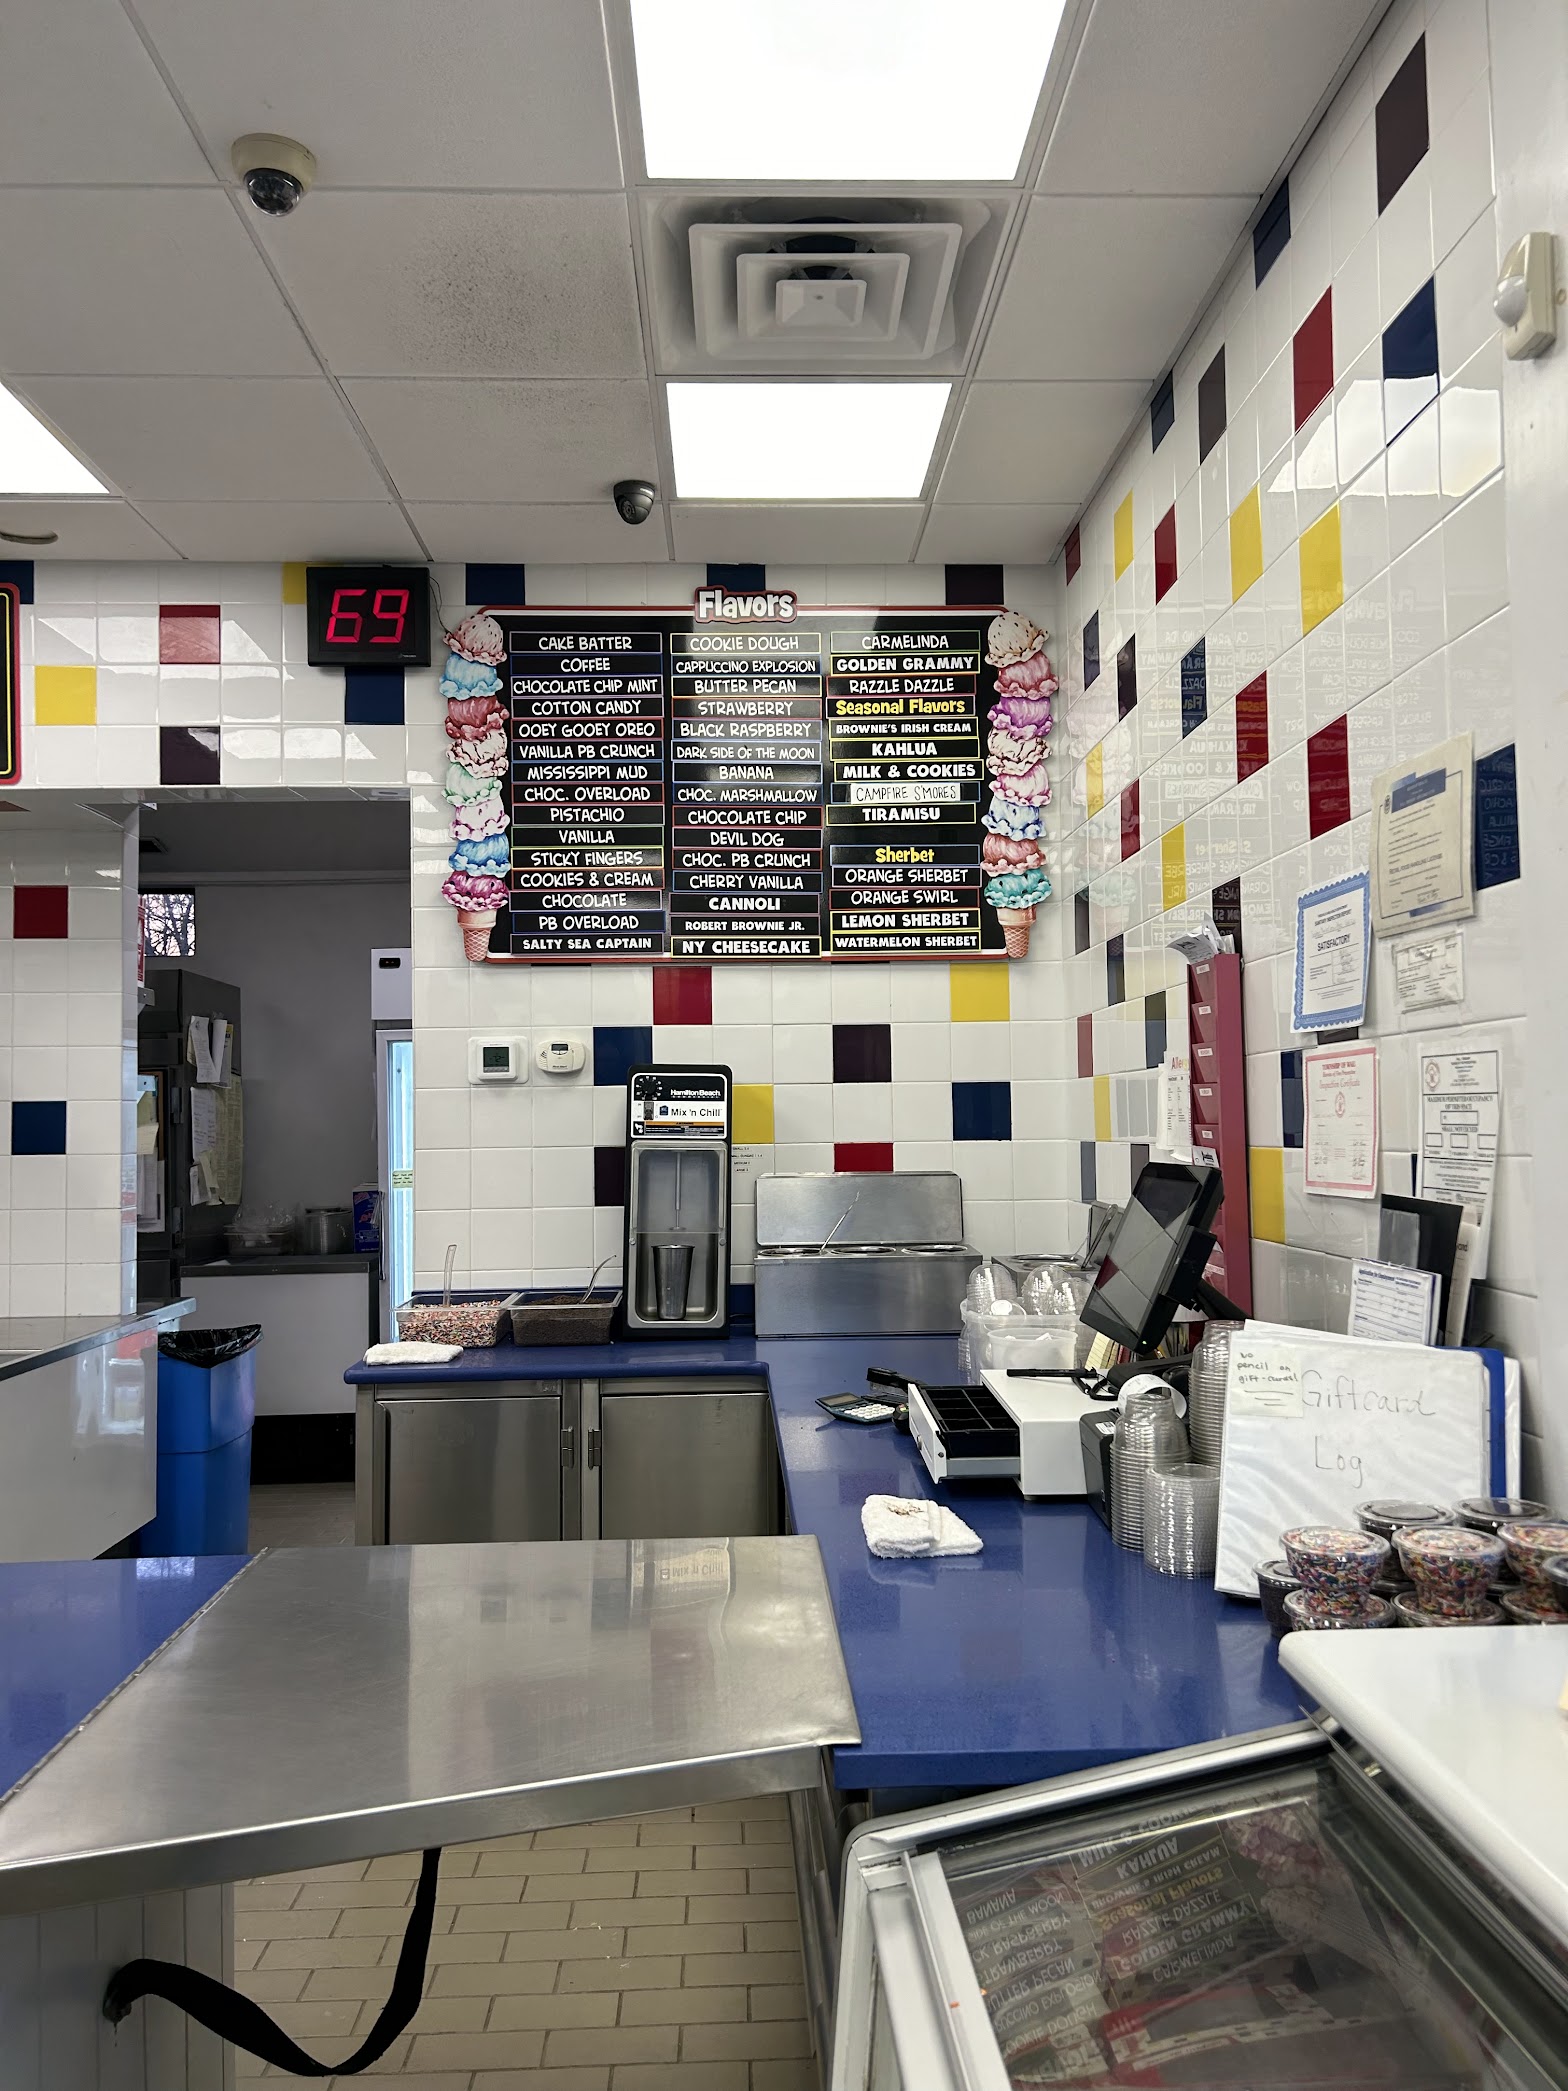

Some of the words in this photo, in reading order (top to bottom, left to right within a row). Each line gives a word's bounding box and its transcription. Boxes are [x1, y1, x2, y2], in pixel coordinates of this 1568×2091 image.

[699, 591, 793, 619] Flavors
[326, 588, 410, 643] 69
[539, 637, 574, 650] CAKE
[578, 637, 632, 649] BATTER
[690, 637, 744, 651] COOKIE
[748, 636, 799, 650] DOUGH
[862, 635, 949, 650] CARMELINDA
[561, 658, 610, 672] COFFEE
[676, 661, 748, 673] CAPPUCCINO
[752, 660, 816, 672] EXPLOSION
[837, 657, 896, 671] GOLDEN
[902, 657, 974, 670] GRAMMY
[513, 680, 590, 693] CHOCOLATE
[594, 680, 623, 693] CHIP
[628, 679, 657, 692] MINT
[694, 680, 748, 693] BUTTER
[753, 679, 796, 693] PECAN
[849, 679, 900, 693] RAZZLE
[904, 678, 954, 692] DAZZLE
[532, 701, 591, 715] COTTON
[596, 700, 641, 714] CANDY
[698, 702, 793, 716] STRAWBERRY
[836, 699, 904, 715] Seasonal
[909, 699, 965, 714] Flavors
[519, 723, 556, 738] OOEY
[561, 723, 609, 738] GOOEY
[615, 722, 655, 737] OREO
[680, 723, 725, 737] BLACK
[730, 723, 811, 737] RASPBERRY
[836, 723, 897, 733] BROWNIE'S
[901, 723, 929, 733] IRISH
[933, 723, 971, 733] CREAM
[520, 745, 573, 759] VANILLA
[577, 745, 595, 758] PB
[600, 744, 654, 758] CRUNCH
[676, 747, 707, 759] DARK
[709, 747, 736, 759] SIDE
[739, 746, 752, 759] OF
[755, 746, 776, 758] THE
[779, 747, 814, 759] MOON
[872, 743, 937, 756] KAHLUA
[527, 766, 610, 780] MISSISSIPPI
[616, 766, 648, 779] MUD
[719, 766, 774, 780] BANANA
[843, 766, 882, 779] MILK
[888, 766, 901, 778] &
[906, 765, 975, 777] COOKIES
[524, 788, 569, 802] CHOC.
[574, 787, 650, 801] OVERLOAD
[678, 789, 716, 802] CHOC.
[720, 789, 817, 802] MARSHMALLOW
[856, 787, 909, 801] CAMPFIRE
[550, 808, 624, 822] PISTACHIO
[688, 810, 772, 825] CHOCOLATE
[776, 811, 806, 825] CHIP
[862, 808, 940, 821] TIRAMISU
[559, 830, 614, 844] VANILLA
[710, 832, 748, 846] DEVIL
[752, 832, 784, 846] DOG
[531, 852, 581, 867] STICKY
[585, 852, 643, 866] FINGERS
[682, 853, 727, 868] CHOC.
[731, 853, 750, 867] PB
[755, 853, 811, 868] CRUNCH
[875, 847, 934, 864] Sherbet
[520, 873, 584, 887] COOKIES
[589, 874, 599, 887] &
[604, 873, 653, 887] CREAM
[690, 875, 744, 889] CHERRY
[748, 874, 804, 890] VANILLA
[845, 869, 903, 883] ORANGE
[907, 869, 969, 882] SHERBET
[542, 894, 627, 908] CHOCOLATE
[709, 897, 781, 911] CANNOLI
[850, 891, 909, 905] ORANGE
[913, 890, 958, 904] SWIRL
[539, 917, 558, 931] PB
[562, 916, 639, 930] OVERLOAD
[685, 922, 728, 931] ROBERT
[731, 922, 785, 931] BROWNIE
[788, 921, 805, 931] JR.
[842, 915, 896, 928] LEMON
[901, 913, 969, 927] SHERBET
[523, 939, 562, 951] SALTY
[568, 939, 591, 950] SEA
[596, 938, 651, 950] CAPTAIN
[682, 941, 707, 953] NY
[712, 940, 810, 953] CHEESECAKE
[835, 936, 921, 948] WATERMELON
[925, 935, 977, 948] SHERBET
[1317, 933, 1351, 952] SATISFACTORY
[671, 1108, 687, 1117] Mix
[699, 1108, 720, 1117] Chill
[1237, 1362, 1269, 1372] pencil
[1315, 1435, 1363, 1489] Log
